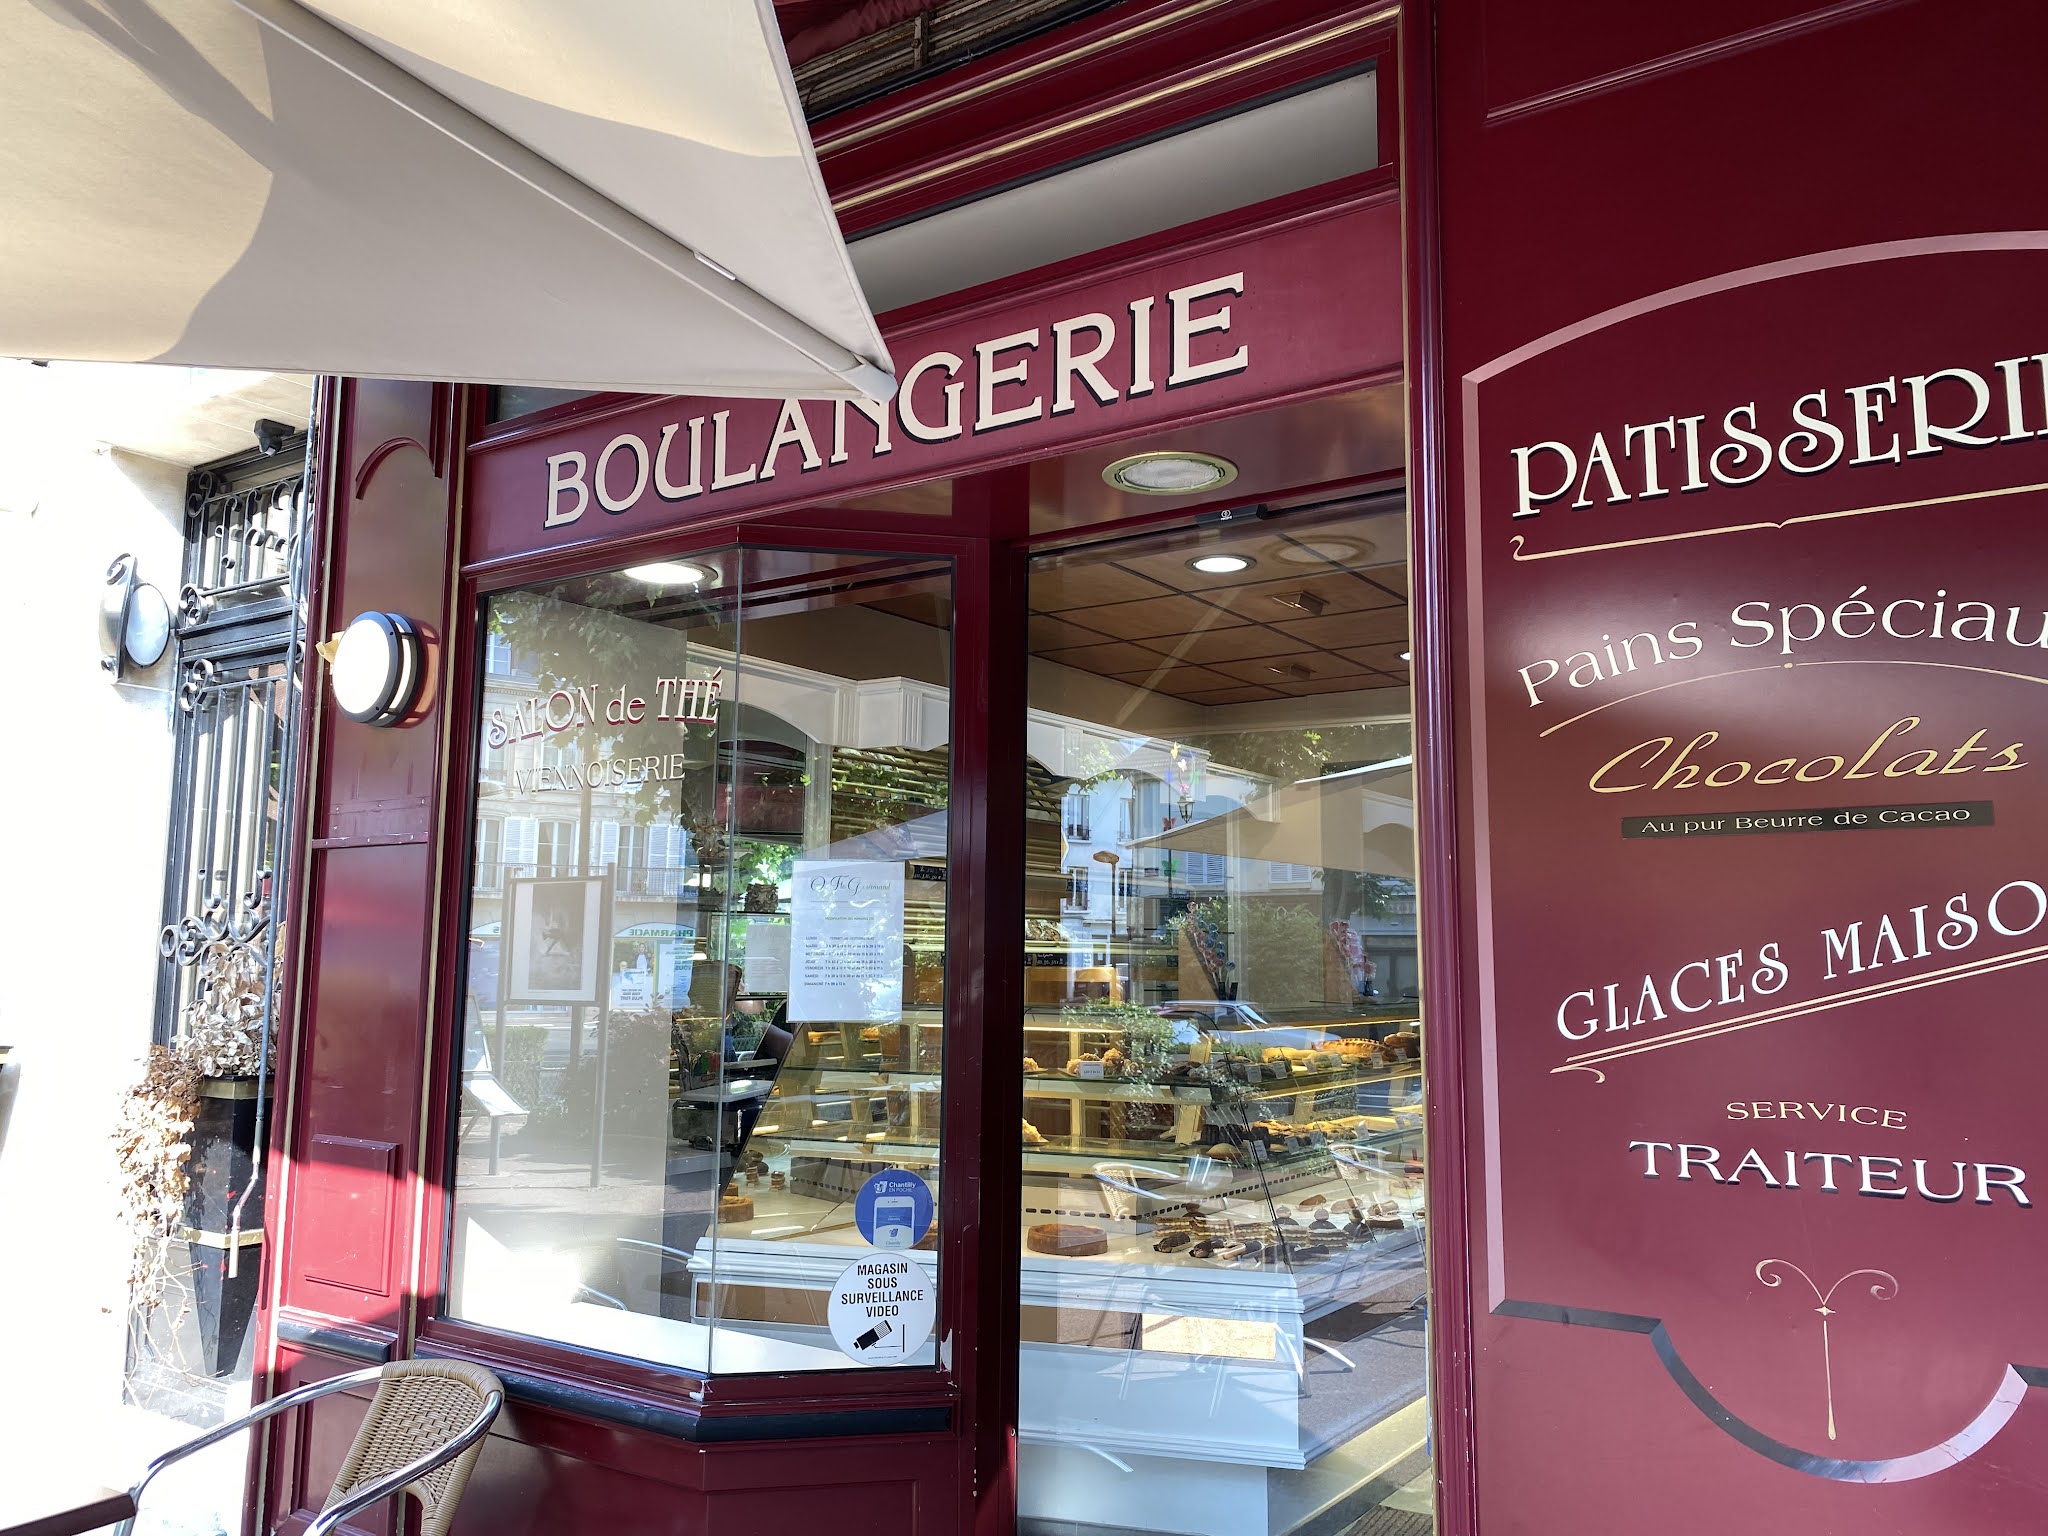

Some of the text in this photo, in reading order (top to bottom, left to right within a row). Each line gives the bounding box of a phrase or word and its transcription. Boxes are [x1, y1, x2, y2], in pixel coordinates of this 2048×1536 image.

[543, 271, 1249, 531] BOULANGERIE
[1517, 585, 2048, 707] Pains Spéciau
[488, 666, 723, 749] SALON de THÉ
[1588, 716, 2029, 794] Chocolats
[515, 753, 686, 795] VIENNOISERIE
[1641, 807, 1971, 834] Au pur Beurre de Cacao
[1555, 879, 2048, 1041] GLACES MAISO
[1726, 1100, 1908, 1130] SERVICE
[888, 1181, 917, 1189] Chantilly
[1629, 1139, 2033, 1209] TRAITEUR
[857, 1262, 908, 1276] MAGASIN
[867, 1277, 898, 1289] SOUS
[841, 1289, 924, 1305] SURVEILLANCE
[865, 1304, 899, 1318] VIDEO
